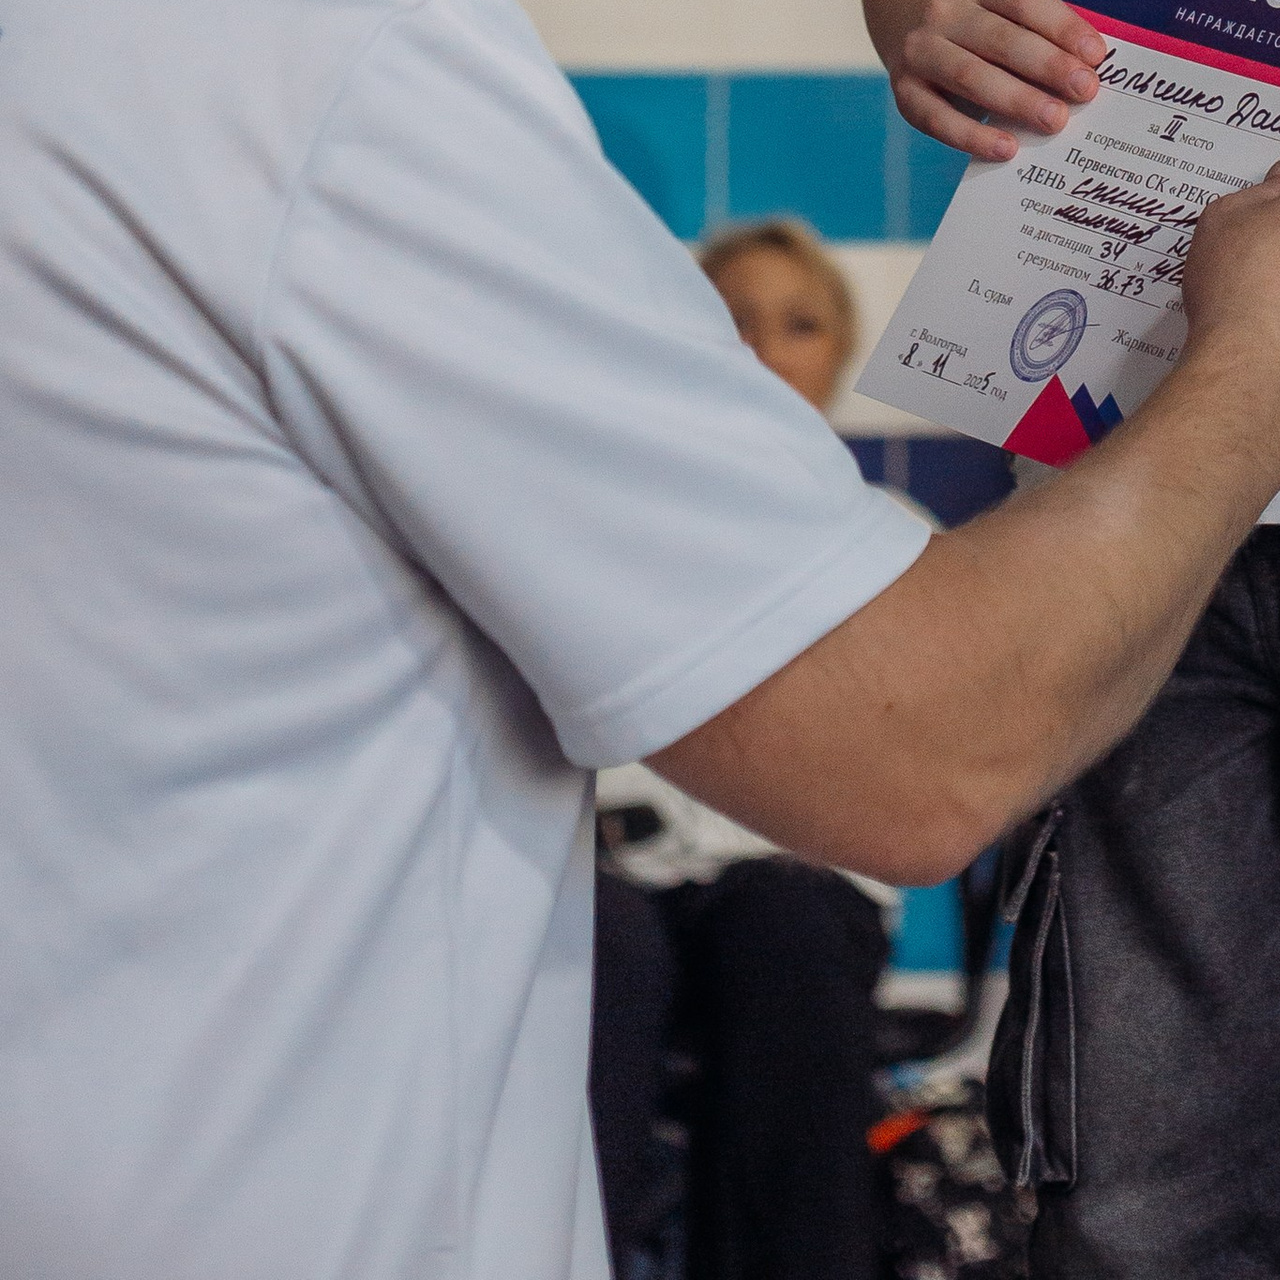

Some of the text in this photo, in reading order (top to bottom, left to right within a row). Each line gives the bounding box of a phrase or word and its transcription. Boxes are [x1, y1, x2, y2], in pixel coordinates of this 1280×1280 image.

[1085, 131, 1092, 140] в
[1093, 133, 1178, 168] соревнованиях
[1178, 160, 1194, 172] по
[1147, 123, 1160, 135] за
[1179, 133, 1214, 151] место
[1017, 164, 1067, 190] «ДЕНЬ
[1064, 148, 1143, 186] Первенство
[1146, 173, 1170, 193] СК
[1020, 197, 1053, 216] среди
[1020, 223, 1033, 236] на
[1033, 230, 1093, 255] дистанции
[1134, 261, 1144, 272] м
[1017, 249, 1026, 260] с
[1023, 252, 1091, 281] результатом
[984, 289, 1014, 306] судья
[1111, 329, 1166, 358] Жариков
[919, 328, 968, 358] Волгоград
[990, 387, 1008, 402] год
